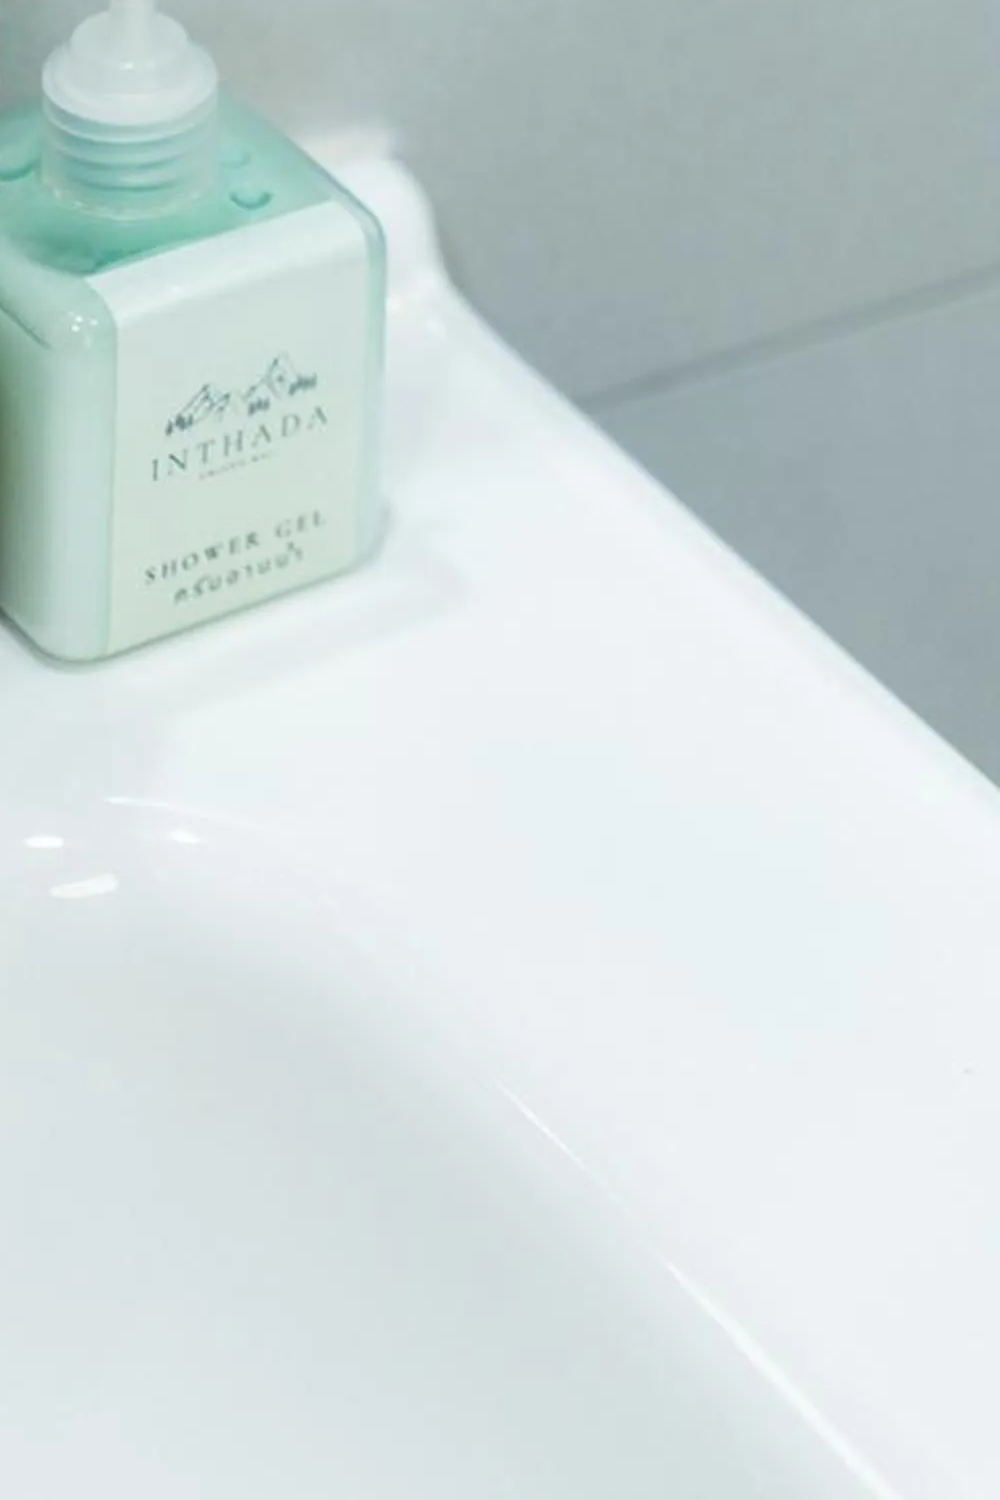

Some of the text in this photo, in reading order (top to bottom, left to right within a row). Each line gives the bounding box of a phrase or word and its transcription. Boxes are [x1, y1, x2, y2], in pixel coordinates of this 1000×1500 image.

[150, 404, 328, 481] INTHADA
[144, 508, 327, 585] SHOWER GEL
